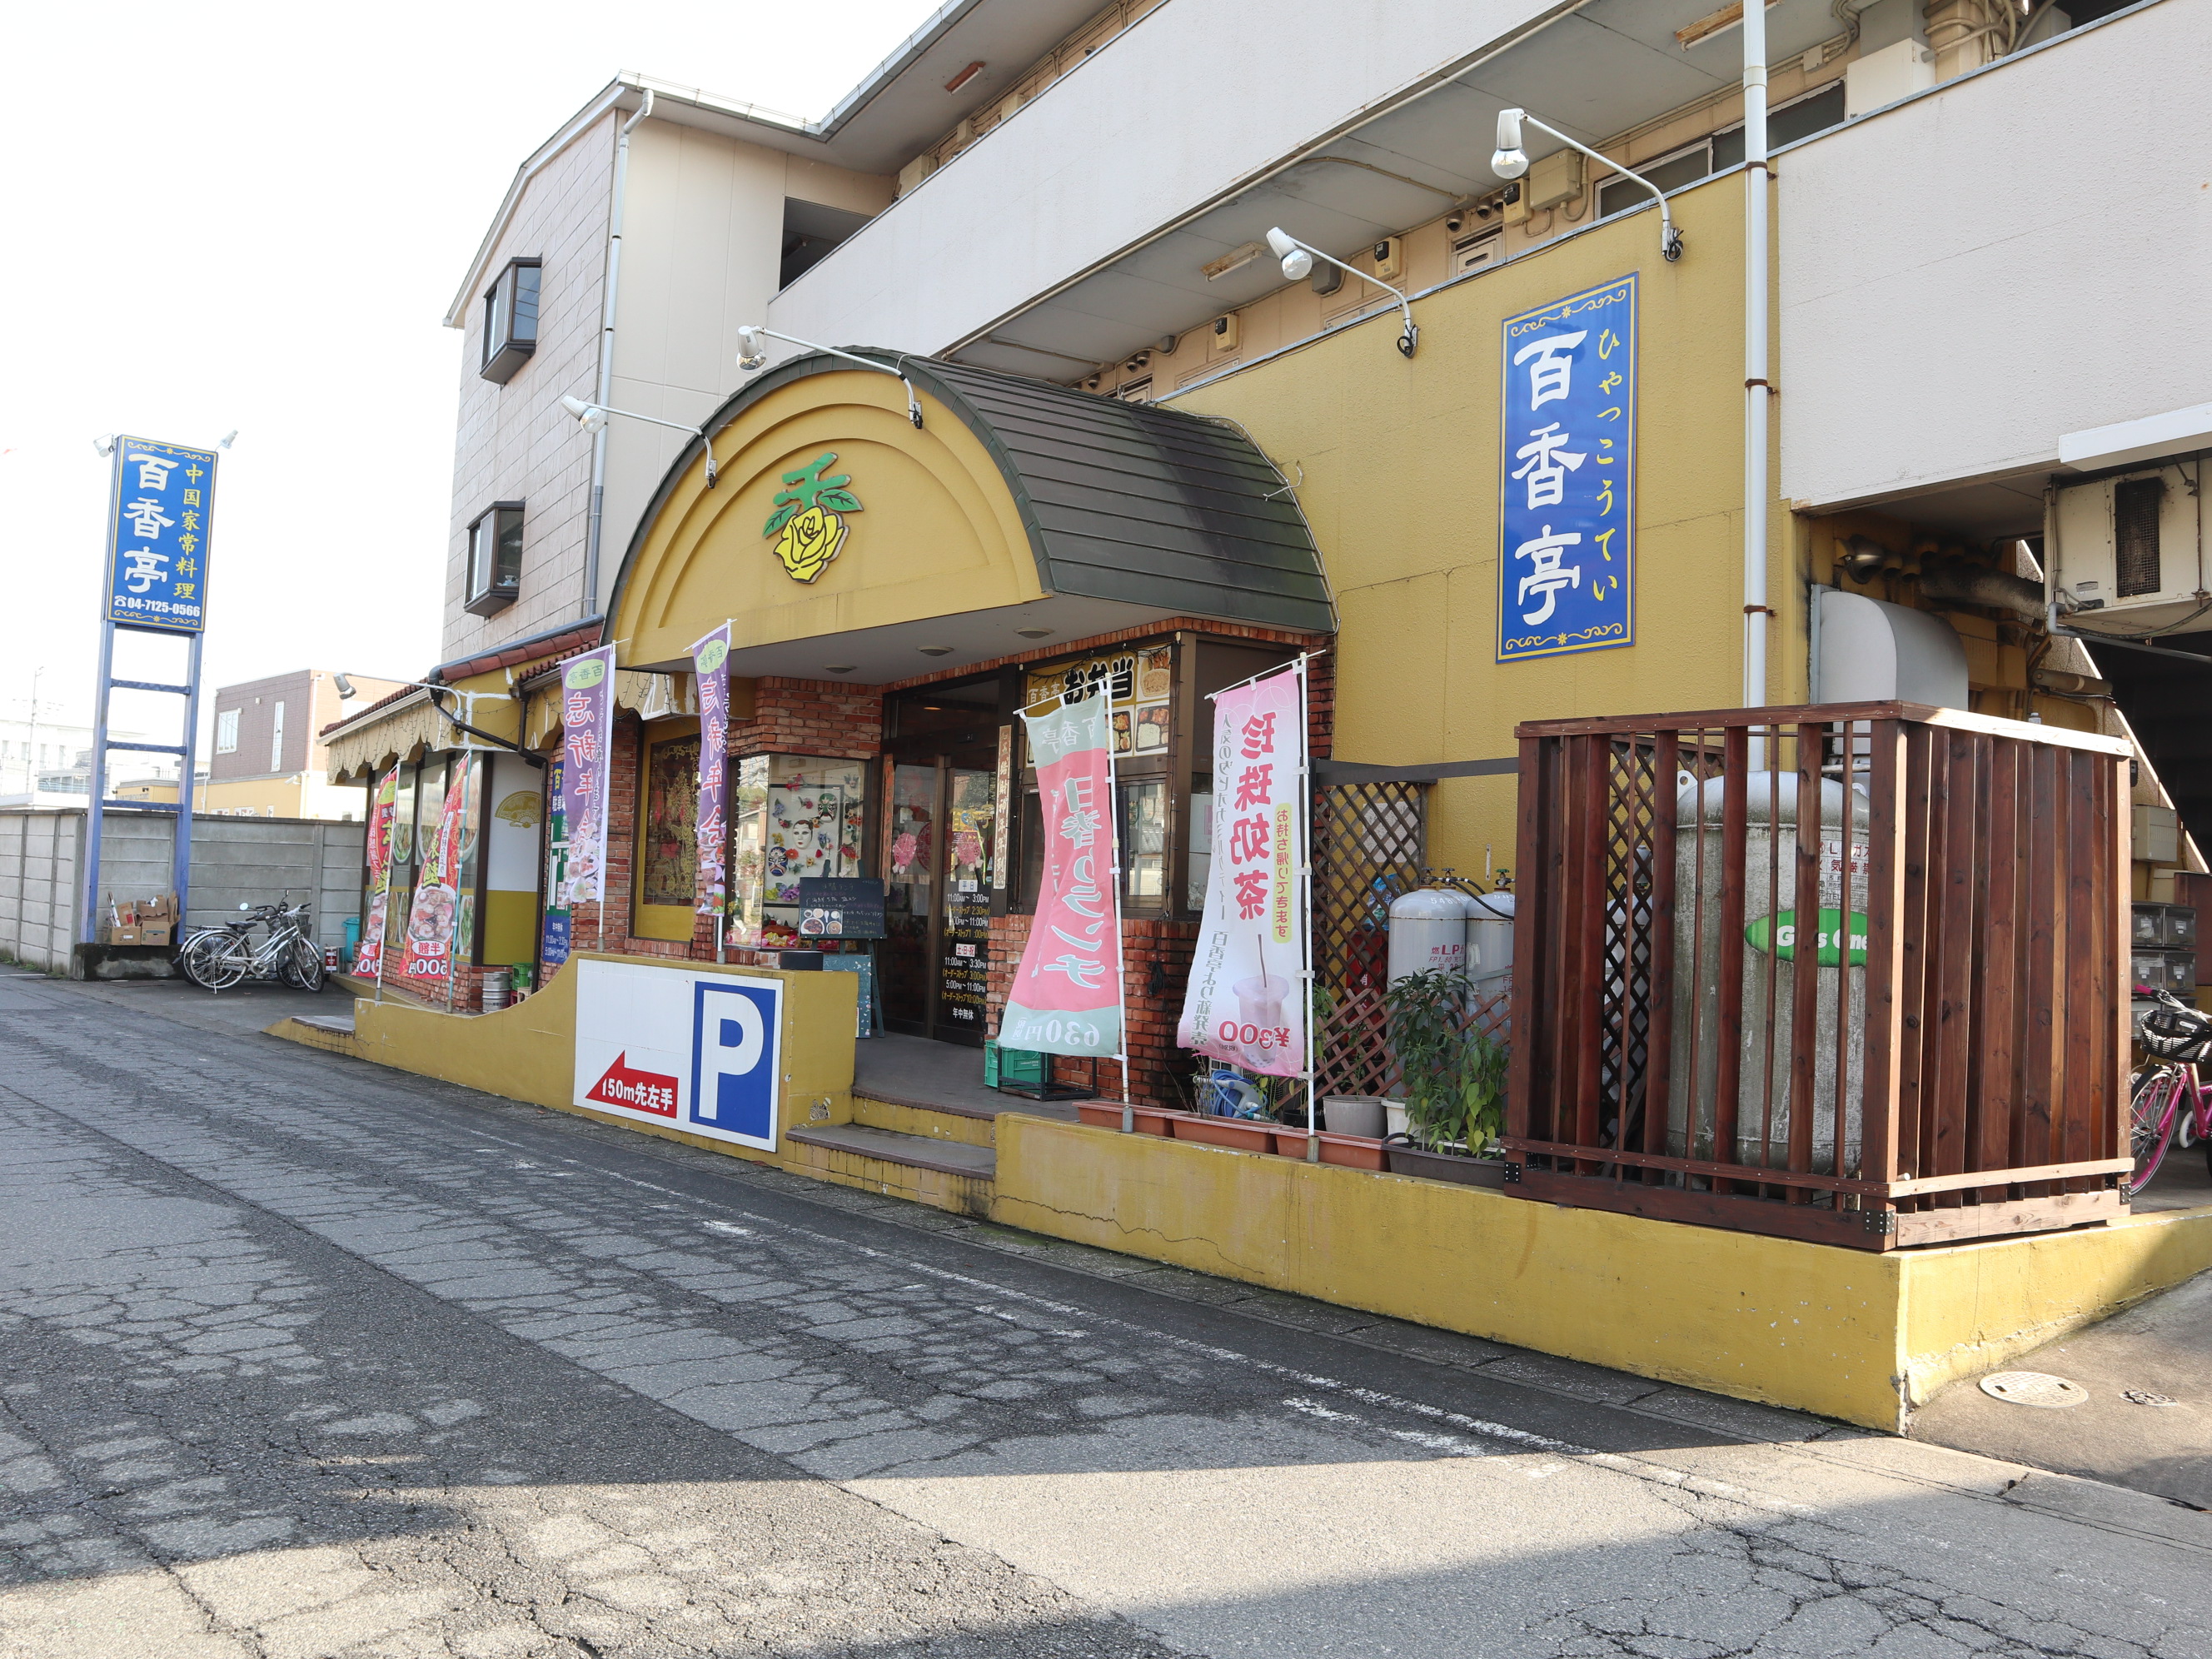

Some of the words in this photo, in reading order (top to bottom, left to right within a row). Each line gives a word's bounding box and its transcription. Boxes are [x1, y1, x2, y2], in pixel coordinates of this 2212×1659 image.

[1511, 329, 1588, 626] 百香亭
[122, 453, 180, 594] 百香亭
[172, 463, 204, 600] 中国家常料理
[127, 596, 201, 618] 04-7125-0566
[1029, 682, 1060, 704] 百香亭
[1064, 656, 1135, 705] お弁当
[1776, 925, 1828, 948] Gs
[952, 1007, 974, 1021] 年中無休
[698, 989, 765, 1121] P
[601, 1078, 674, 1113] 150m先左手
